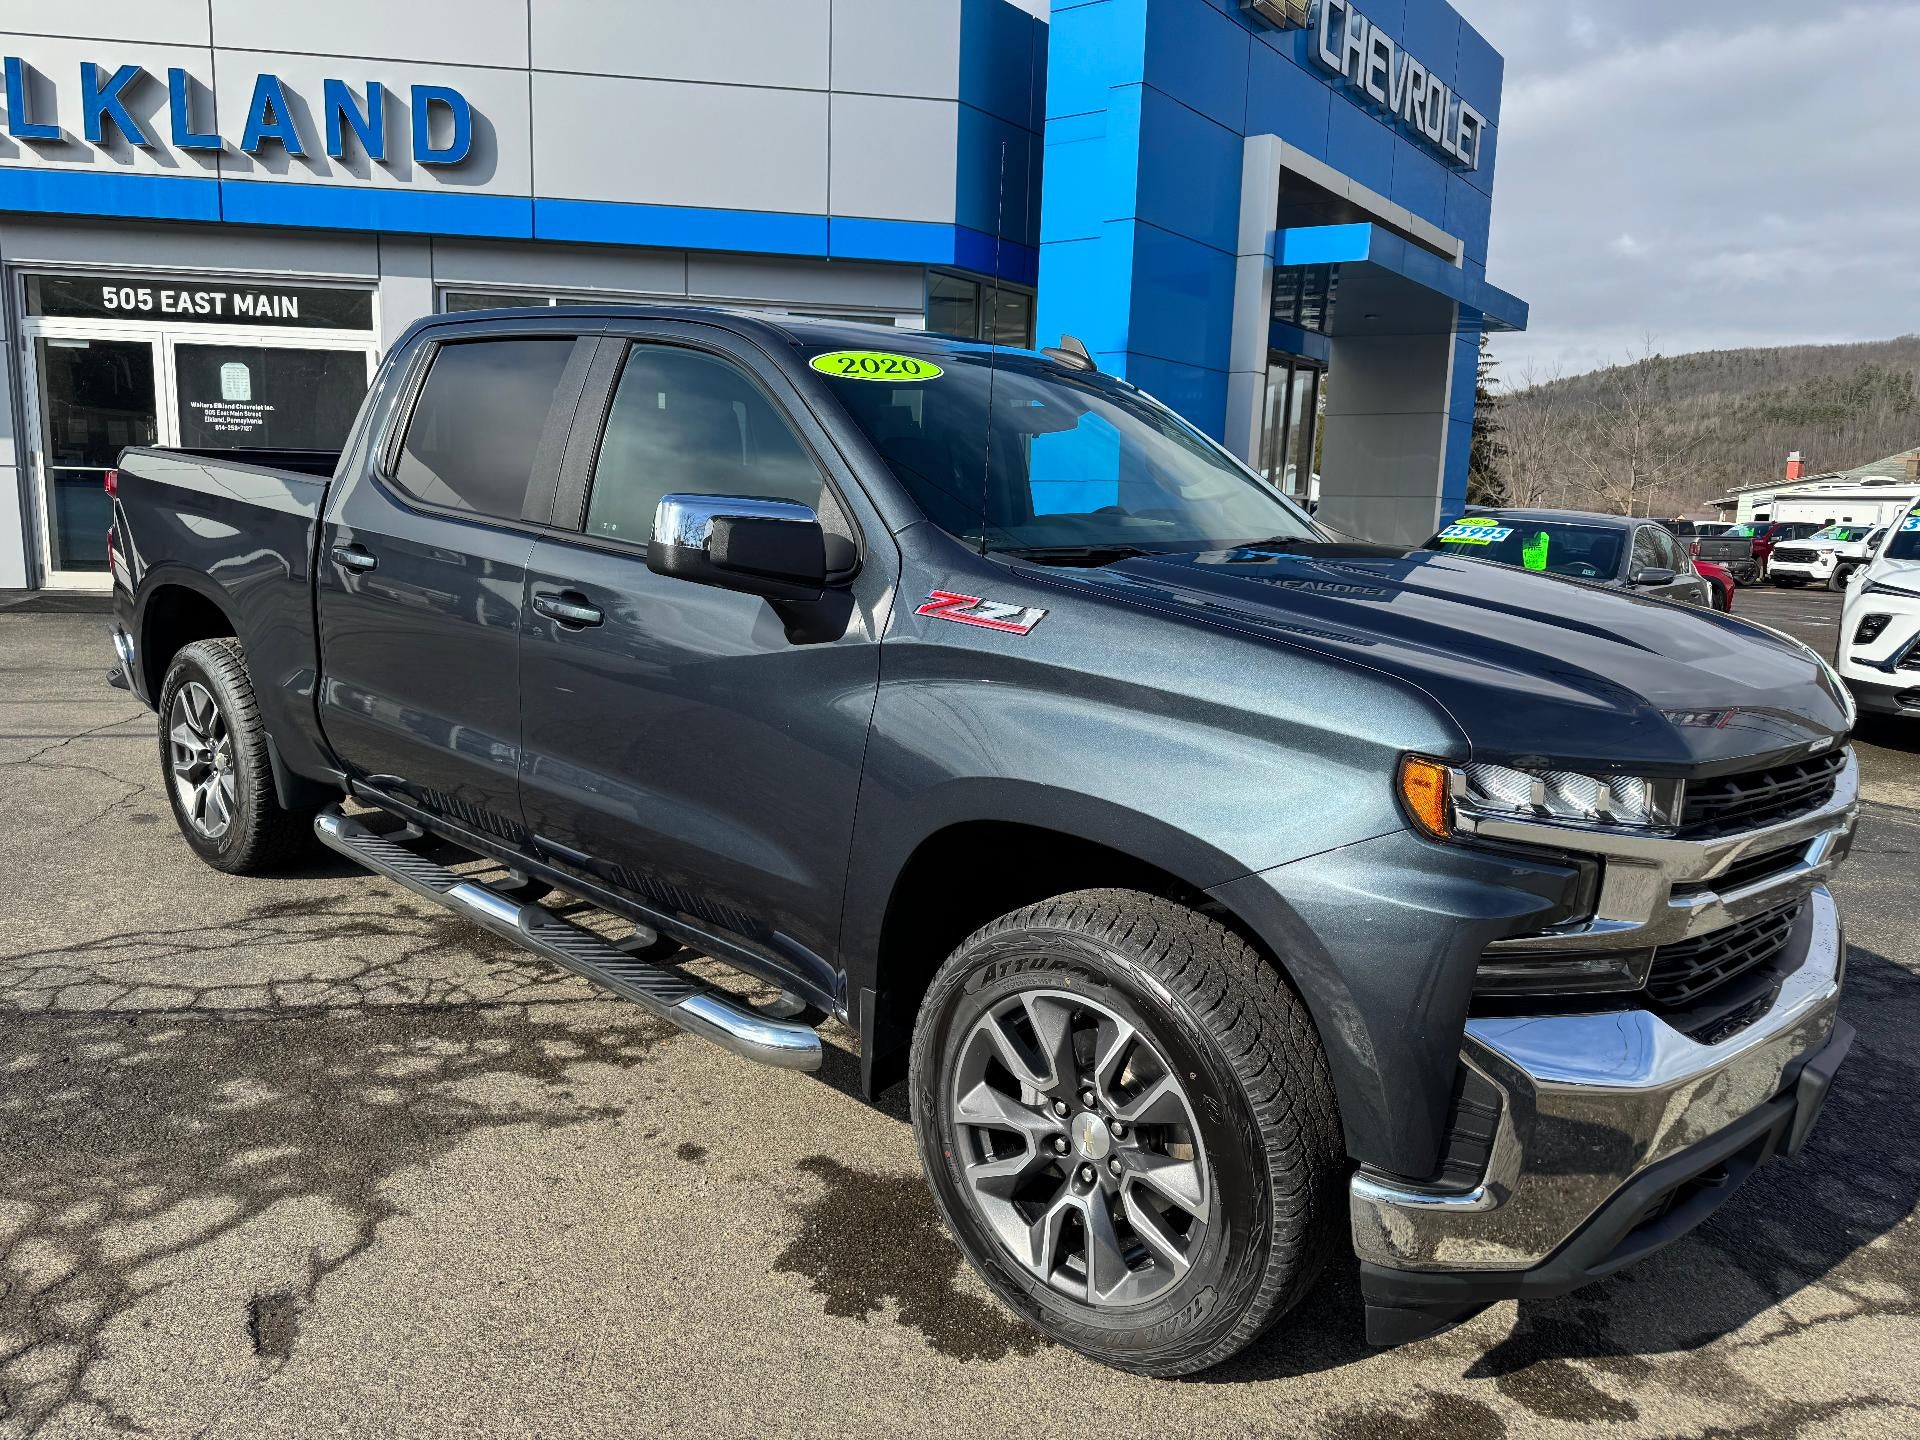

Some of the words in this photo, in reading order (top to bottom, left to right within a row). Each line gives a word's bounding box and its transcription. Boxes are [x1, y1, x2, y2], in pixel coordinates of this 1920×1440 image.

[1319, 0, 1487, 170] CHEVROLET
[102, 286, 153, 310] 505
[161, 290, 226, 315] EAST
[233, 293, 299, 318] MAIN
[837, 357, 921, 375] 2020
[1441, 526, 1510, 539] 25995
[914, 589, 1050, 636] Z71
